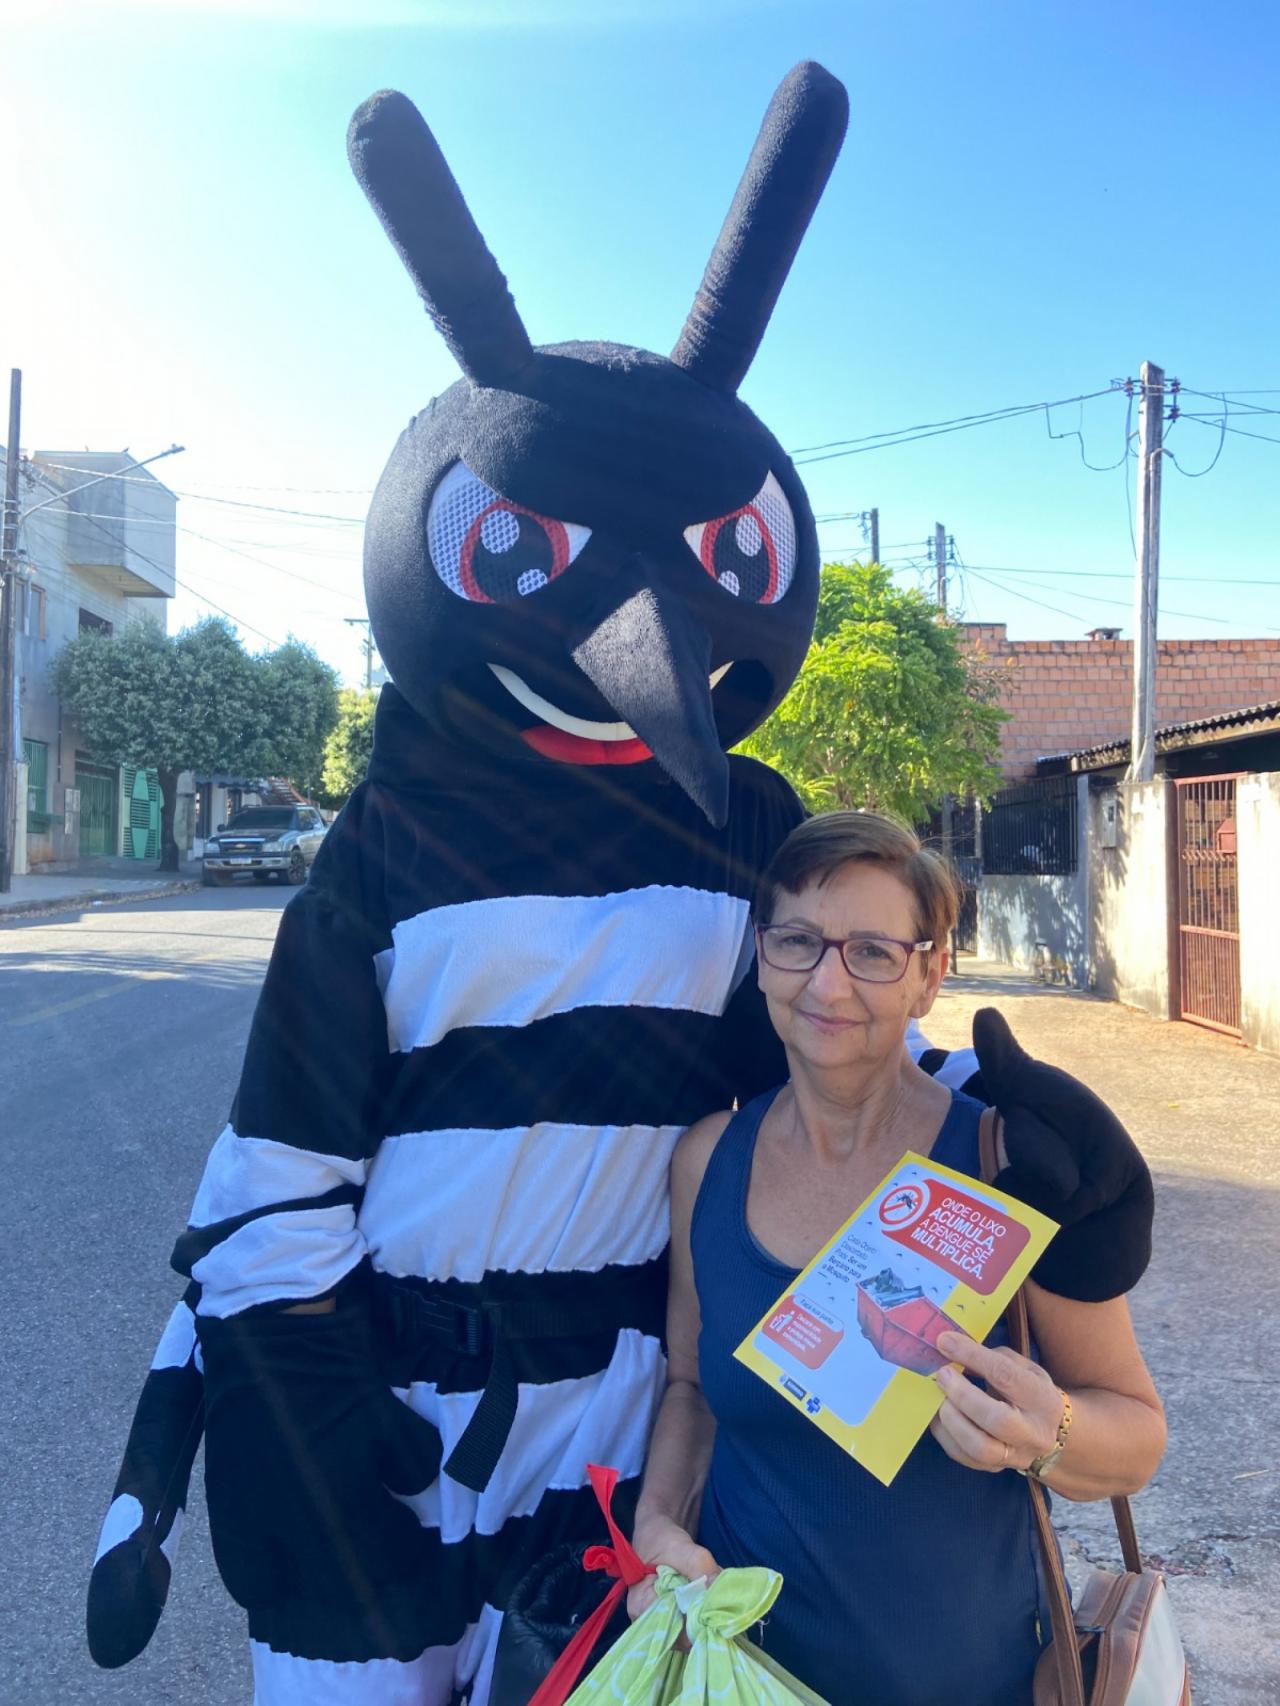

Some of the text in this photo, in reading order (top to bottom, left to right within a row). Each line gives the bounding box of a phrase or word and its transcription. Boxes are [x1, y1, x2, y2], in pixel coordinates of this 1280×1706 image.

[919, 1217, 991, 1264] A DENGUE SE
[928, 1206, 995, 1254] ACUMULA,
[942, 1197, 1006, 1237] ONDE O LIXO
[910, 1226, 982, 1280] MULTIPLICA.
